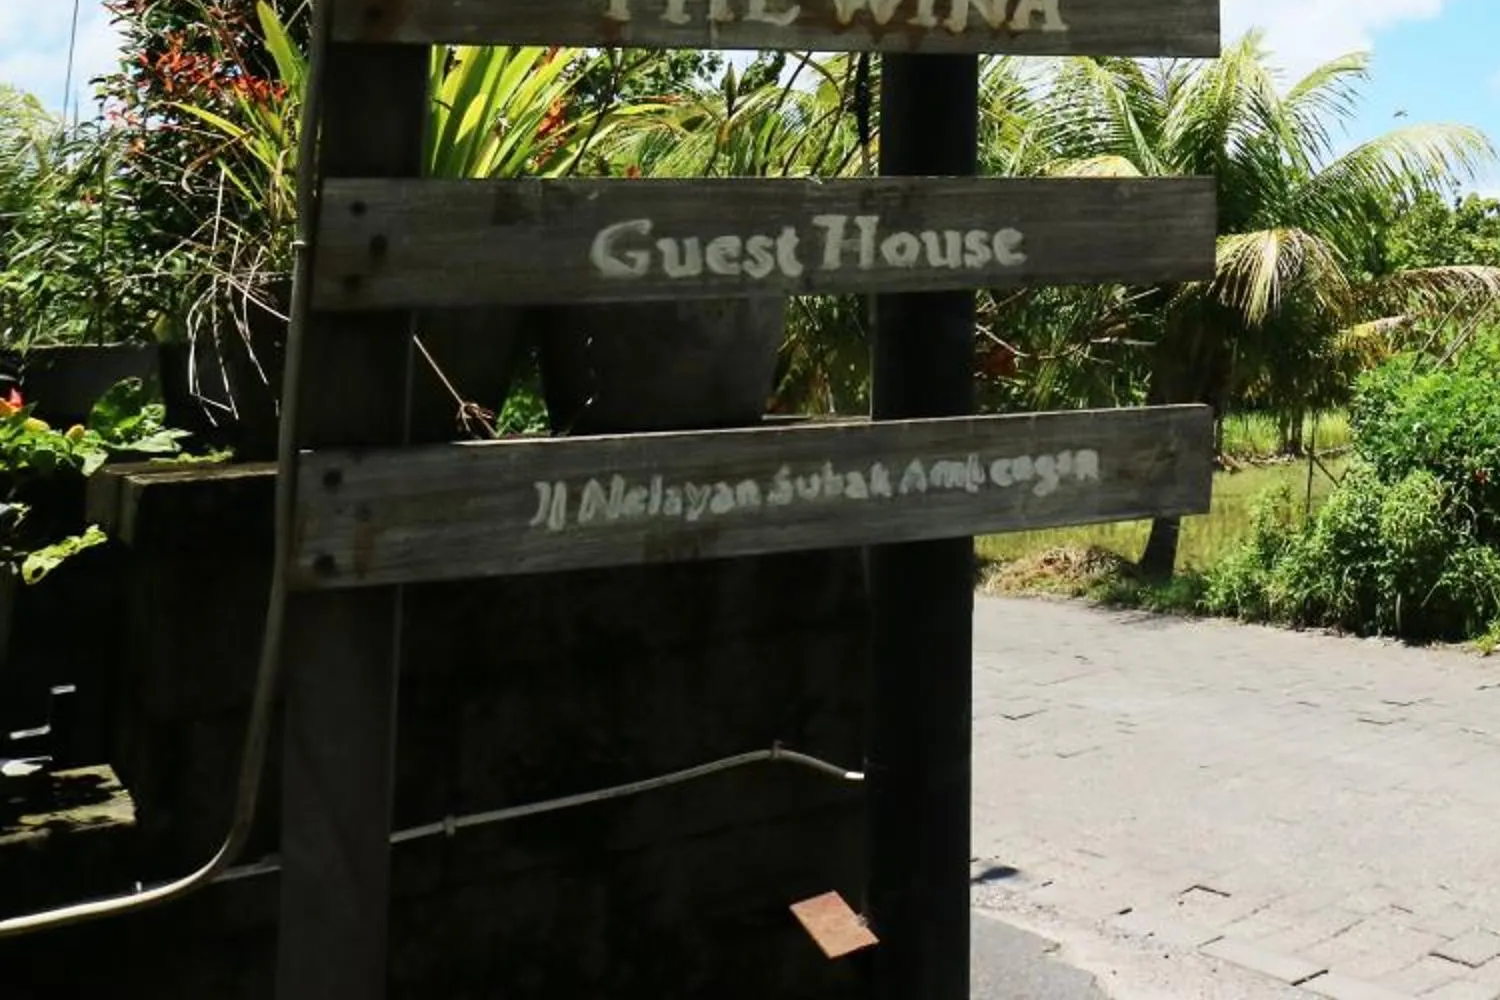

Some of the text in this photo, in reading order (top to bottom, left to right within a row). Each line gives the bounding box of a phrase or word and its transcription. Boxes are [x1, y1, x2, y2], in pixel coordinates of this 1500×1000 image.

[590, 213, 1028, 280] Guest House
[578, 473, 762, 524] Nelayan
[767, 459, 892, 506] Subak
